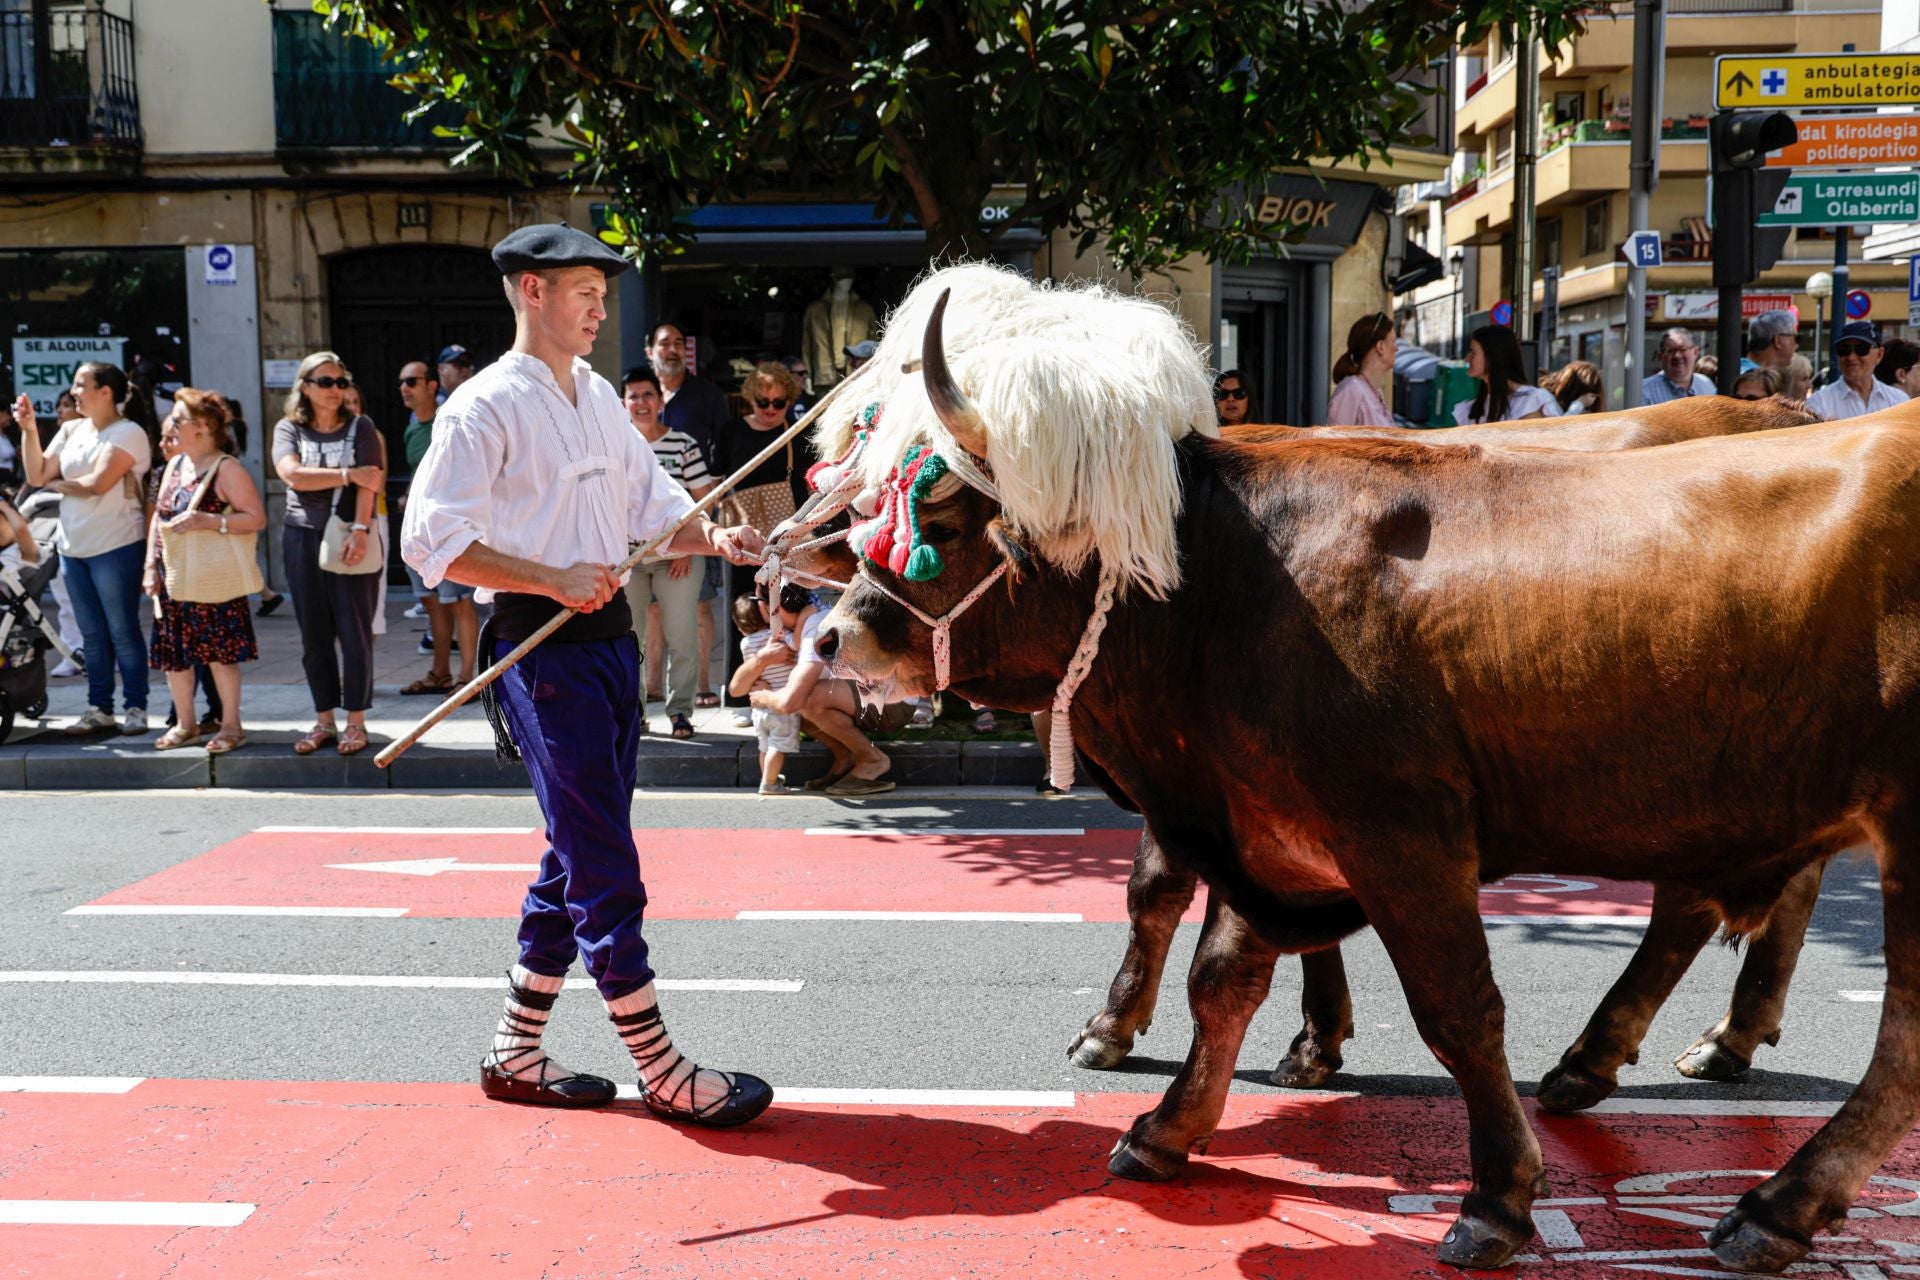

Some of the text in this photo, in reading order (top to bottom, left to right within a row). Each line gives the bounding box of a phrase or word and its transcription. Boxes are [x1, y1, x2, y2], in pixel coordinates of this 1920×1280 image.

[1804, 61, 1920, 80] anbulategia
[1804, 82, 1920, 98] ambulatorio
[1797, 122, 1918, 141] dal kiroldegia
[1806, 141, 1918, 163] polideportivo
[1815, 181, 1917, 198] Larreaundi
[1827, 200, 1915, 216] Olaberria
[1641, 243, 1655, 260] 15
[25, 341, 111, 352] SE ALQUILA
